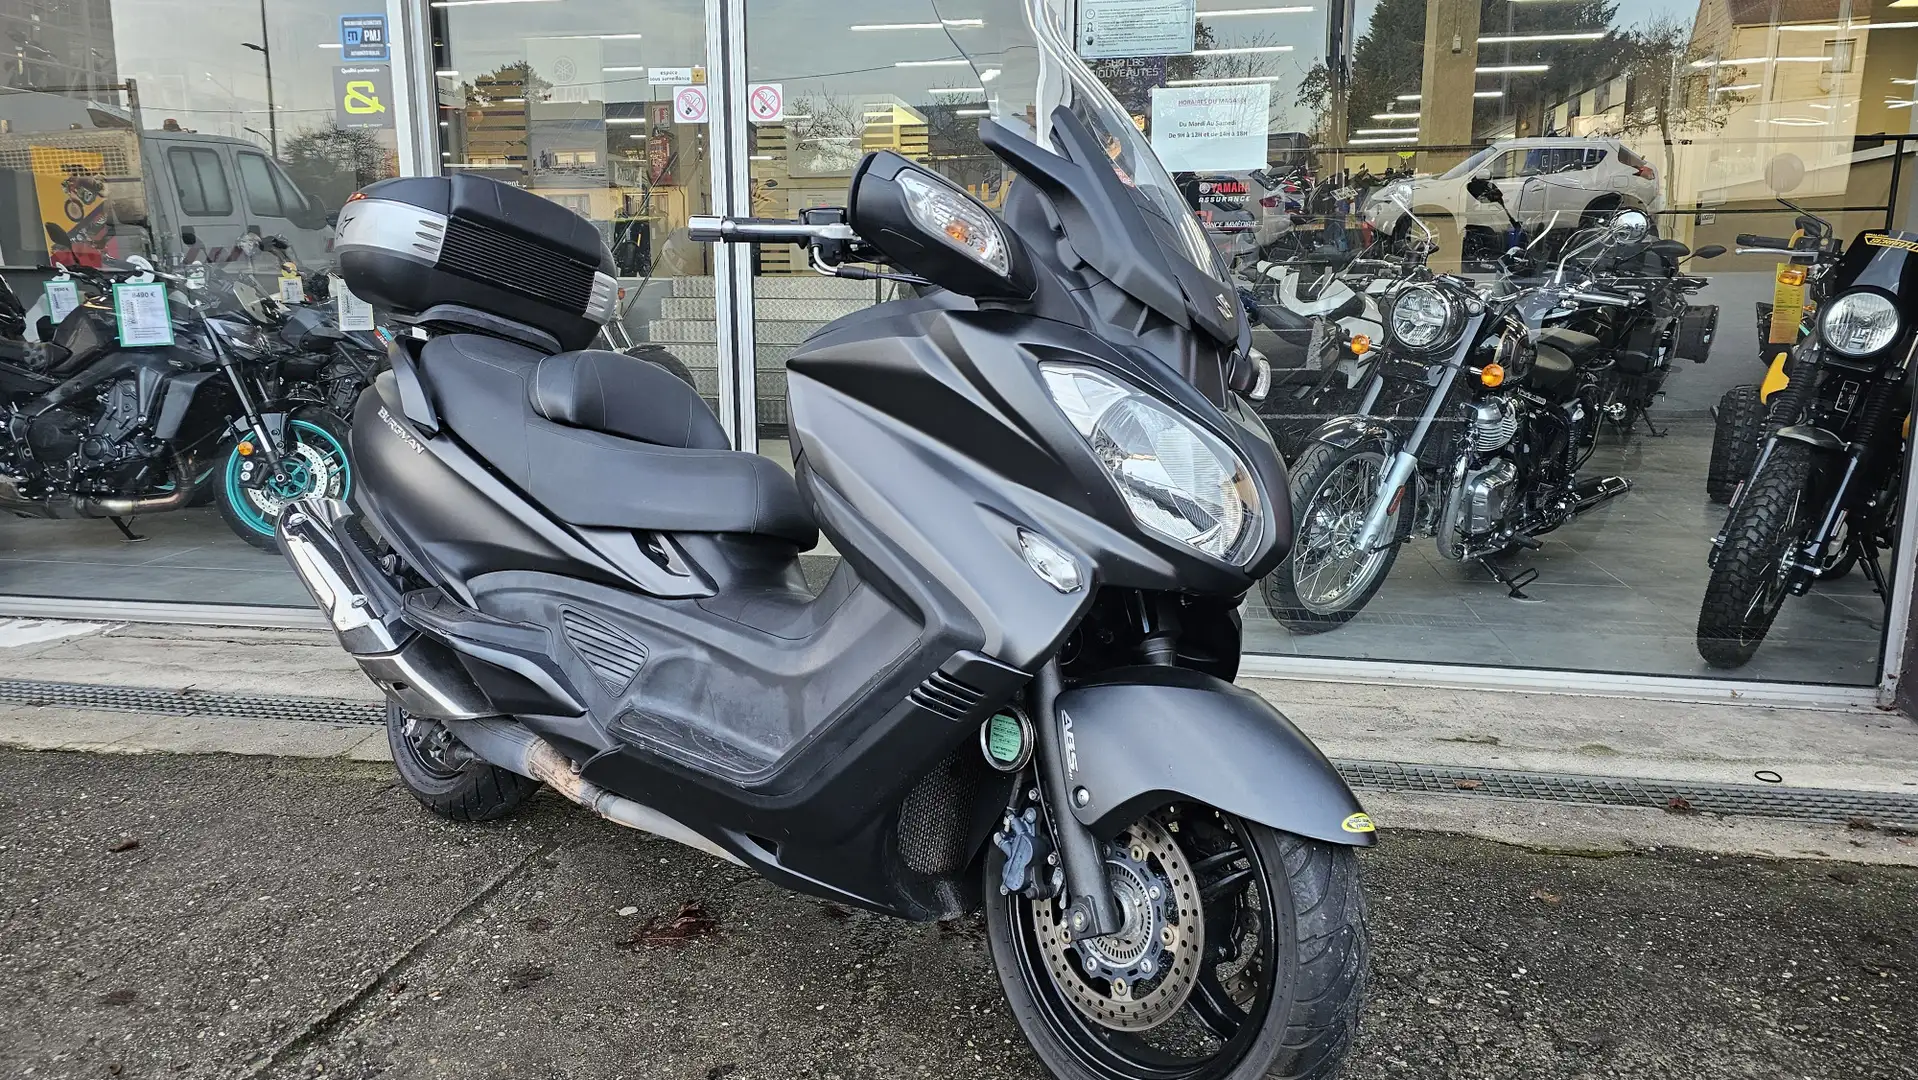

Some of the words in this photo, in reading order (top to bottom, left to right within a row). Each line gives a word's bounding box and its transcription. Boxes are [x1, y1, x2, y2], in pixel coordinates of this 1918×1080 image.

[363, 29, 382, 42] PMJ
[1210, 182, 1251, 193] YAMAHA
[1198, 195, 1251, 203] ASSURANCE
[377, 405, 425, 454] BURGMAN
[1061, 709, 1079, 772] ABS
